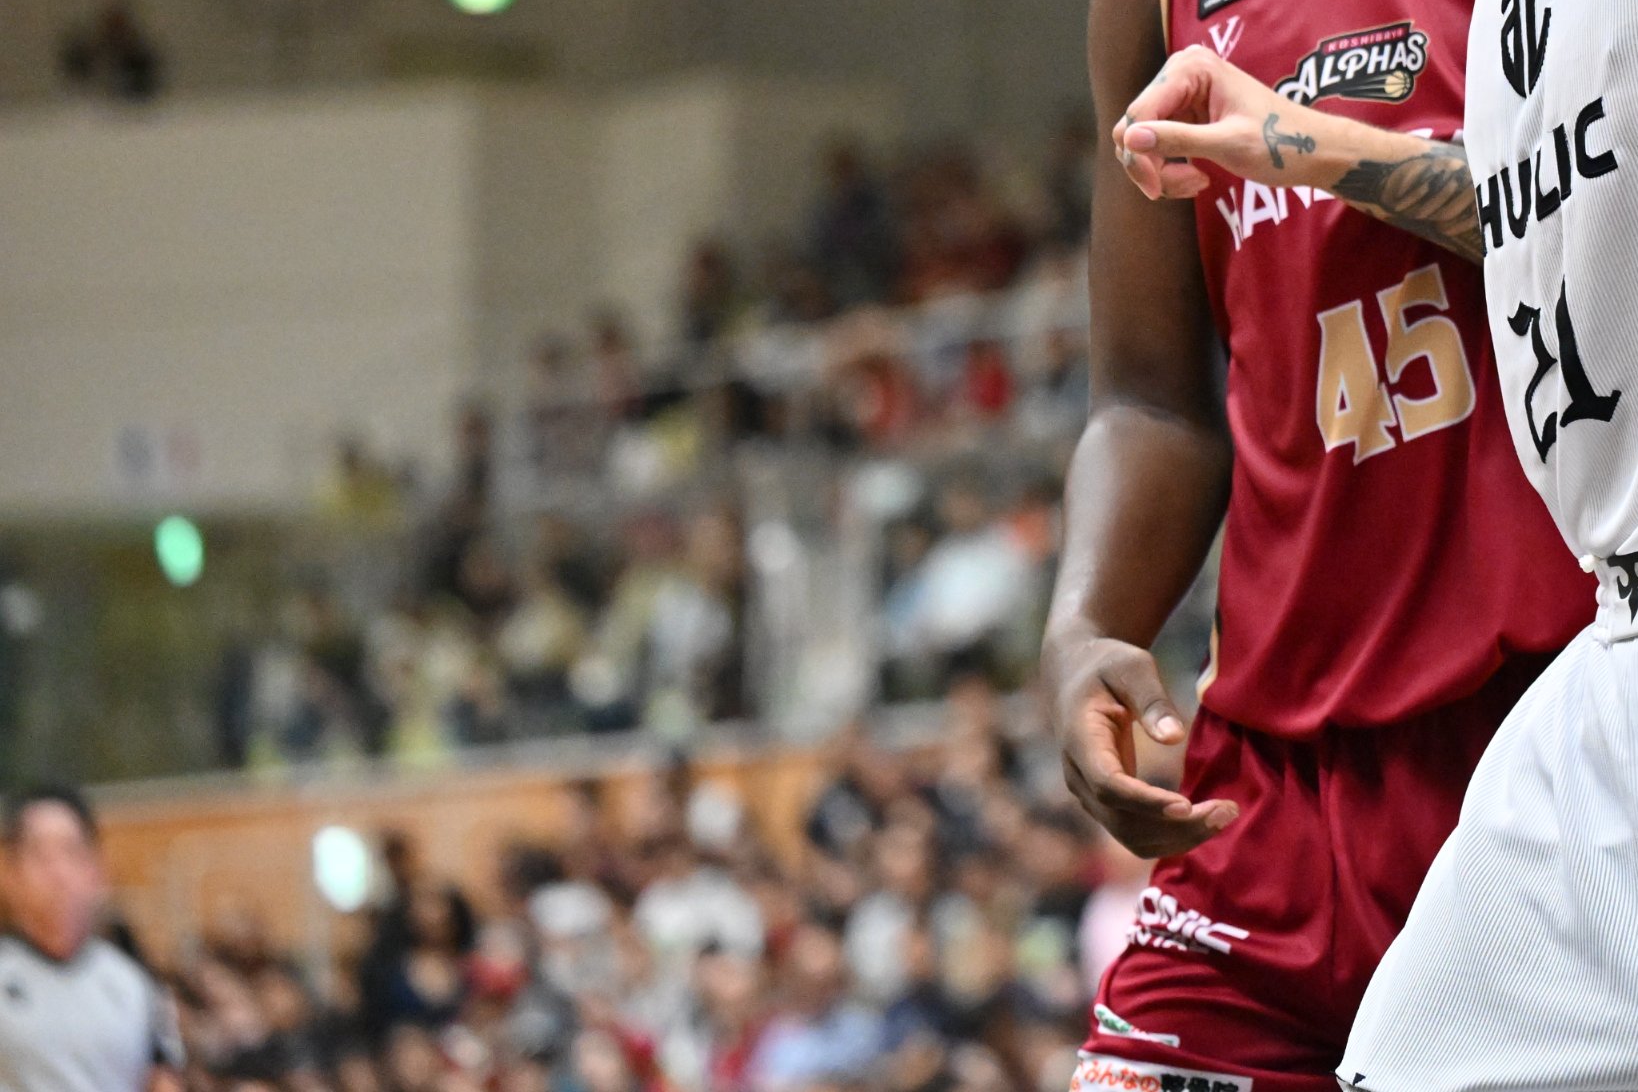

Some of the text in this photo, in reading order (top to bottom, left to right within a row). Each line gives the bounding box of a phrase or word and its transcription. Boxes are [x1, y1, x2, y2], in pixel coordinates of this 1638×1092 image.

[1277, 33, 1425, 104] ALPHAS
[1475, 96, 1619, 258] HULIC
[1316, 262, 1477, 467] 45
[1507, 273, 1623, 465] 21
